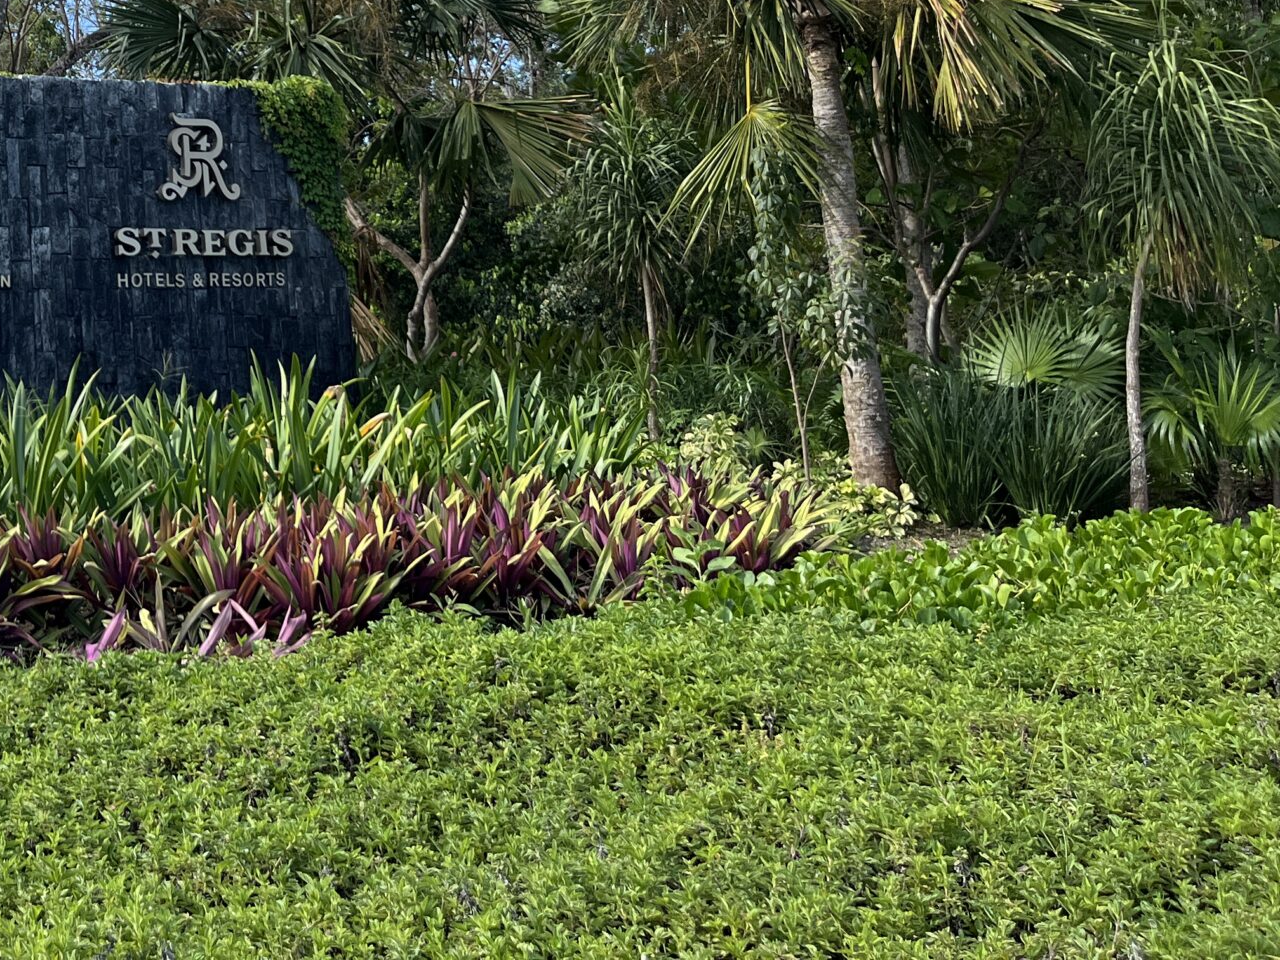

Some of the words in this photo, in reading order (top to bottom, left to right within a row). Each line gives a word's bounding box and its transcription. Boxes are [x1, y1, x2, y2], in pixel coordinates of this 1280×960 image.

[173, 228, 294, 257] REGIS
[117, 272, 186, 288] HOTELS
[192, 272, 204, 288] &
[209, 272, 286, 287] RESORTS
